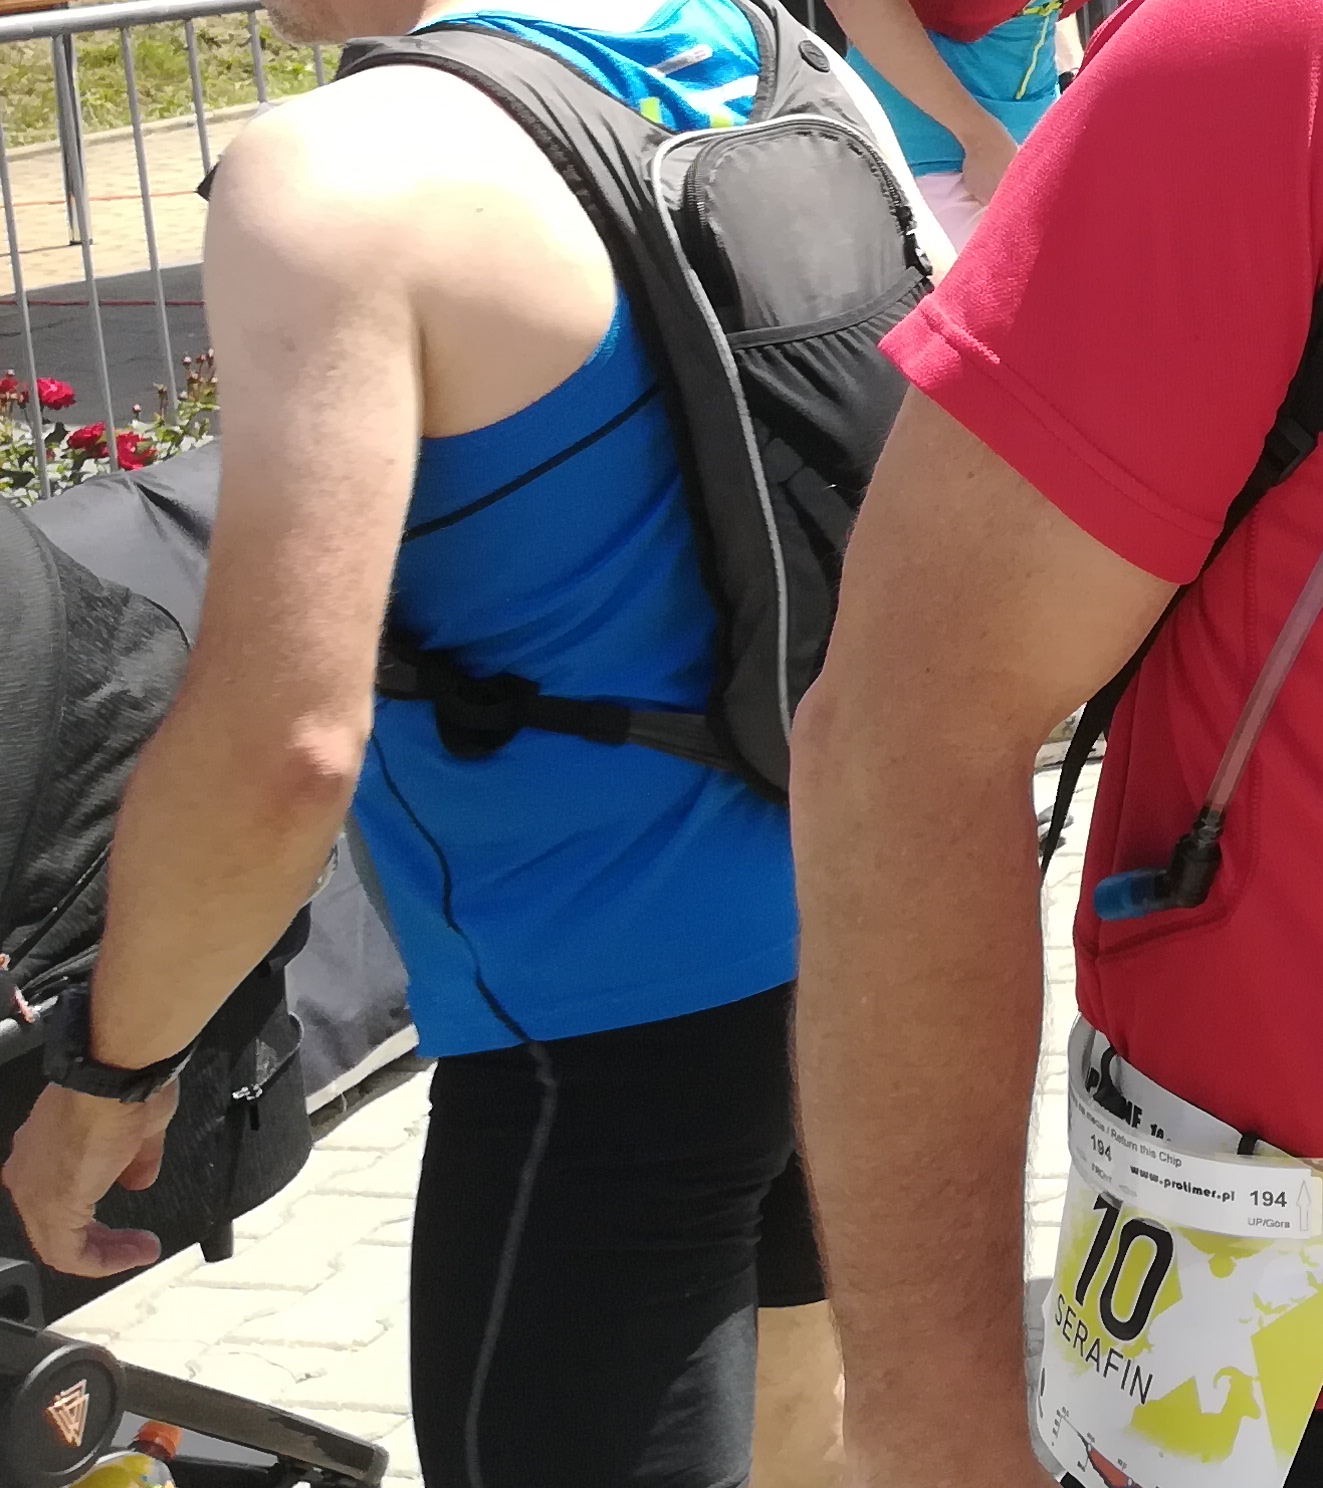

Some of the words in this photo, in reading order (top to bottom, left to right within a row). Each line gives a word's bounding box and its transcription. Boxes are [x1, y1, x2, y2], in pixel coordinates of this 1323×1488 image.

[1090, 1134, 1112, 1162] 194
[1130, 1164, 1236, 1203] www.protimer.pl
[1249, 1190, 1288, 1208] 194
[1110, 1128, 1138, 1151] Return
[1139, 1144, 1157, 1159] this
[1159, 1151, 1183, 1167] Chip
[1075, 1190, 1174, 1341] 10
[1055, 1293, 1154, 1405] SERAFIN
